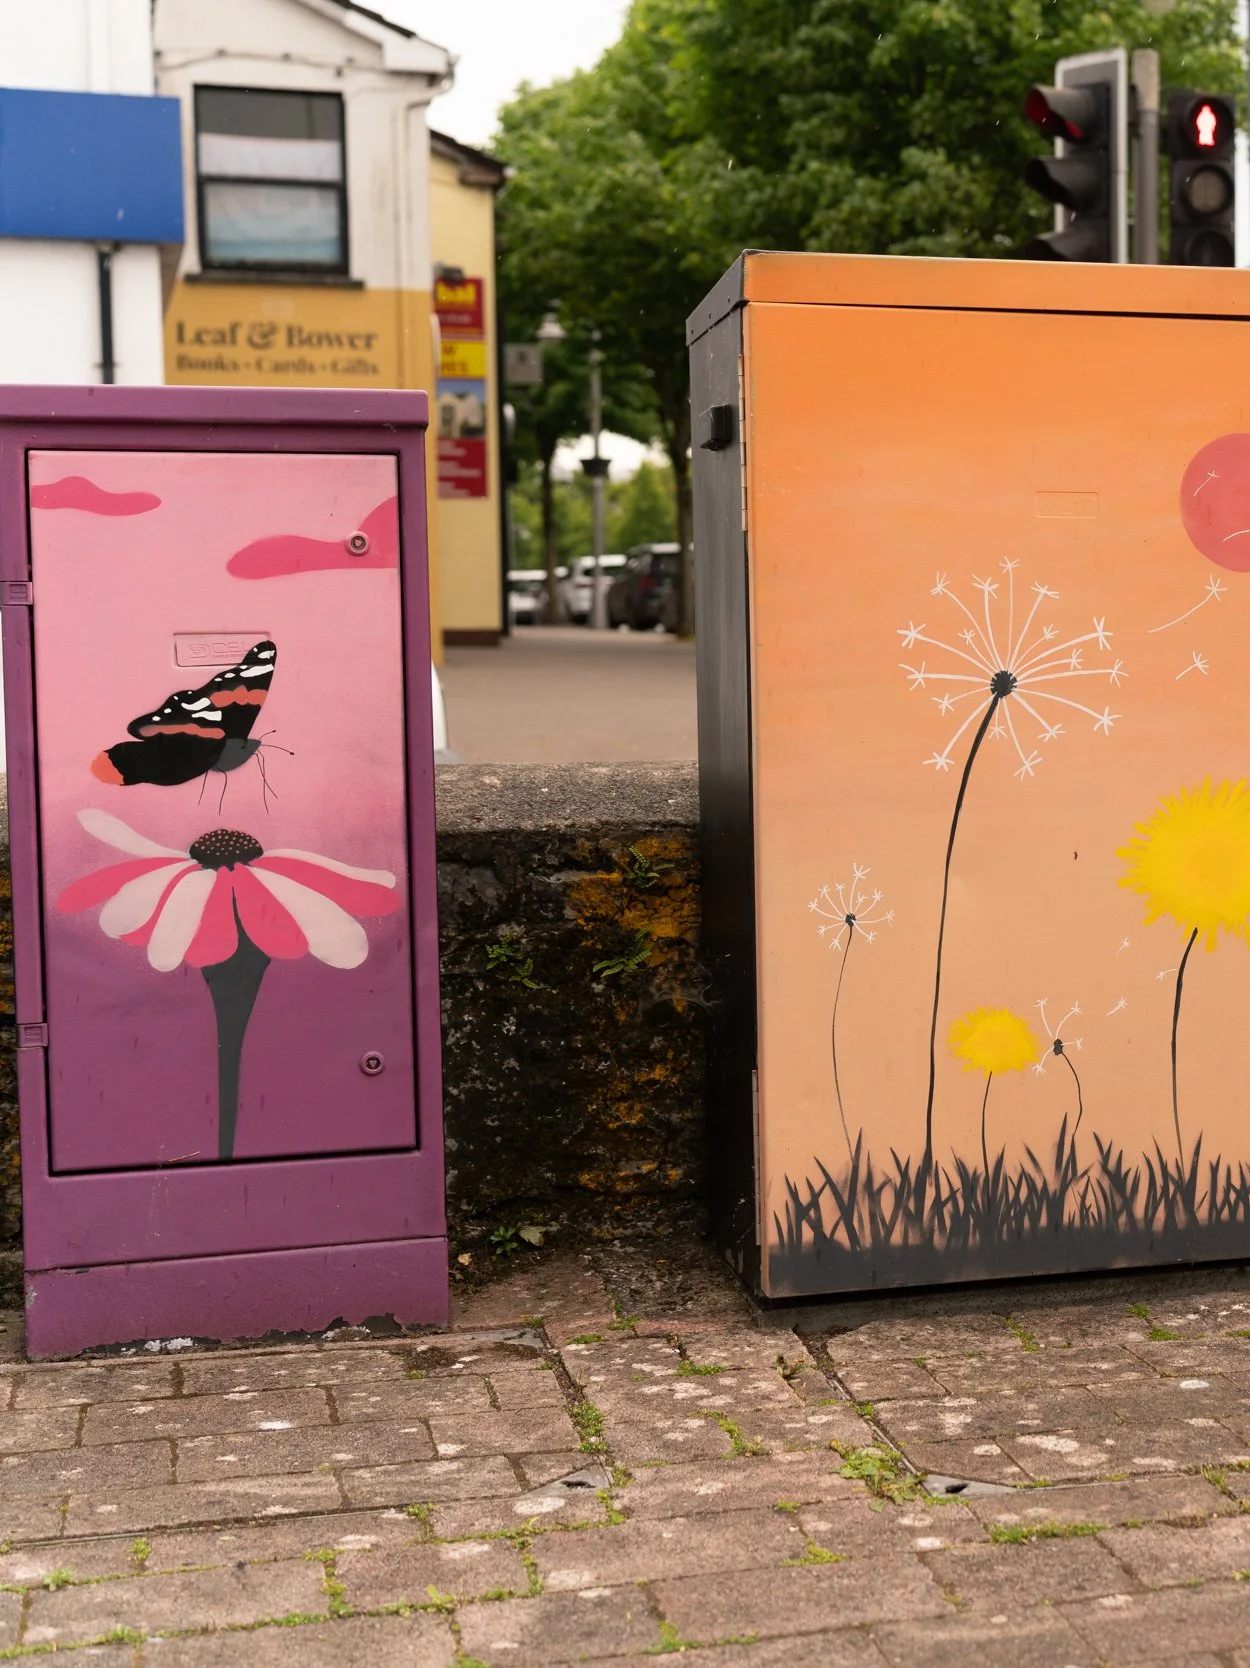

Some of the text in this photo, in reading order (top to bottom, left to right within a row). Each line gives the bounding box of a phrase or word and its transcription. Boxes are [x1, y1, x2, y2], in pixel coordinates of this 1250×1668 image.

[176, 320, 379, 350] Leaf & Bower
[175, 353, 379, 375] Books Cards Gifts
